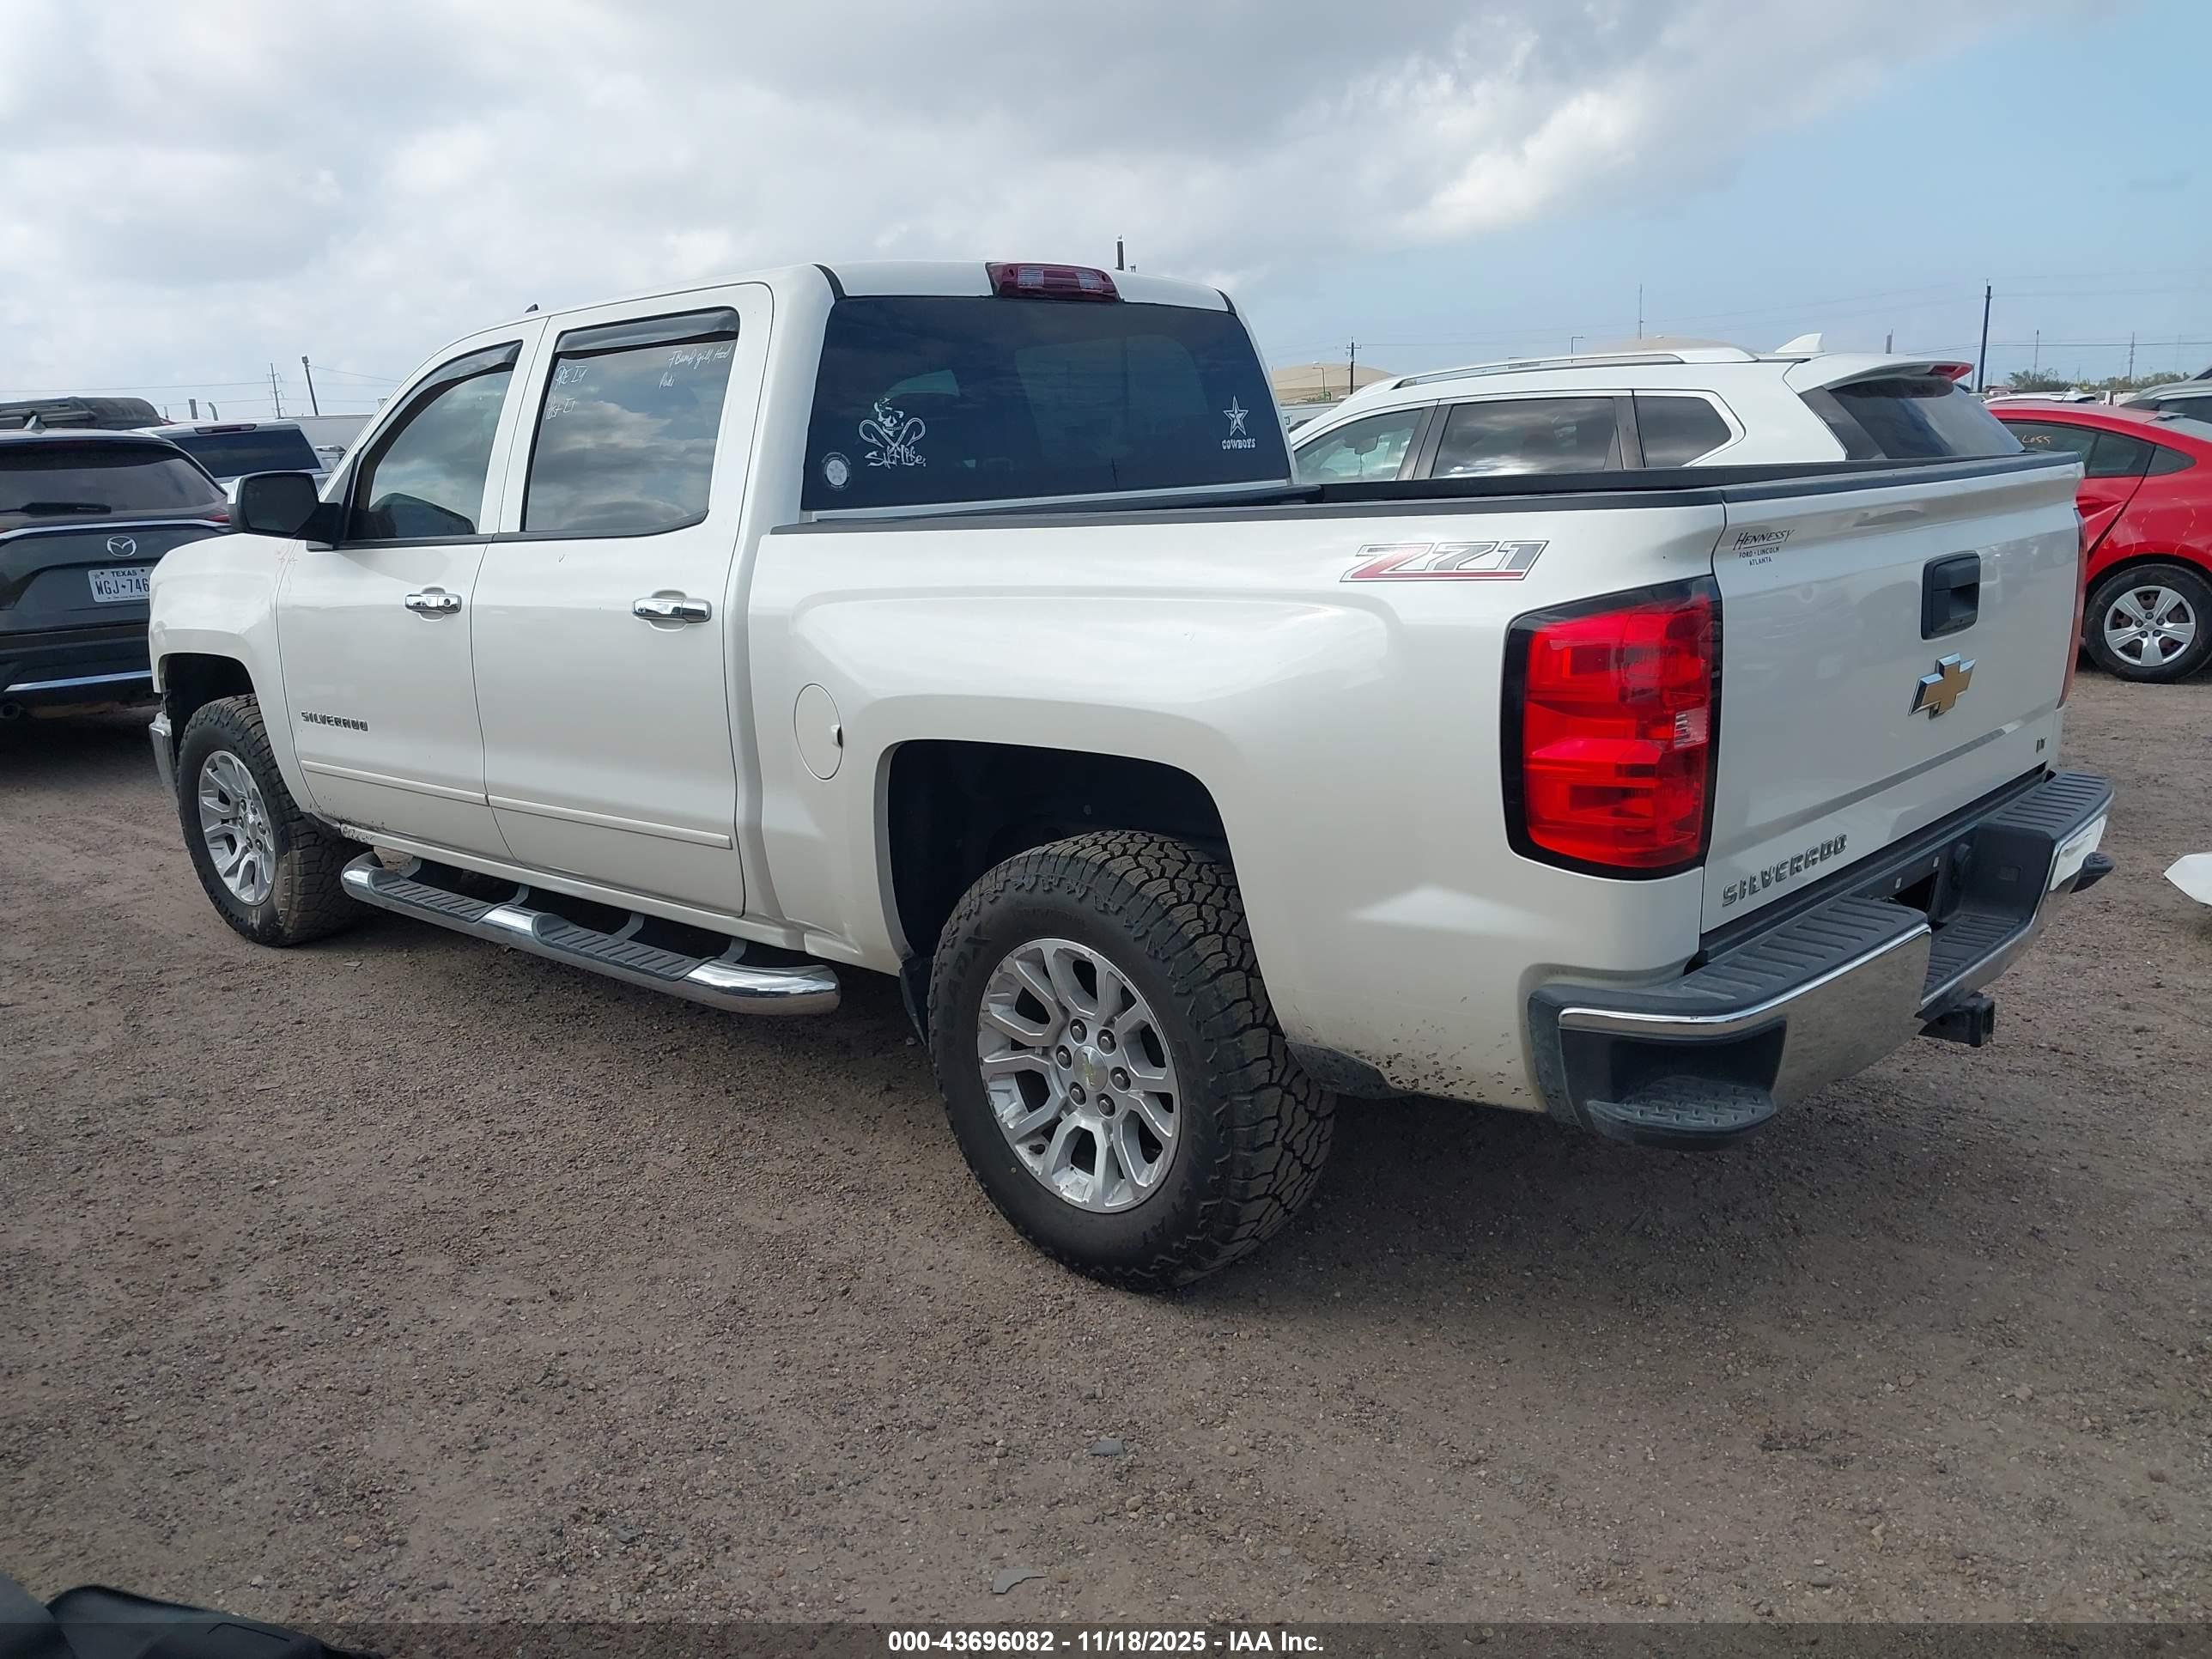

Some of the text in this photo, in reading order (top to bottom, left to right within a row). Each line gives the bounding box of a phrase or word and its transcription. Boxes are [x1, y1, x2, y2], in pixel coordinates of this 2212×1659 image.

[1221, 438, 1256, 450] COWBOYS
[1733, 529, 1796, 551] HENNESSY
[1757, 546, 1780, 556] LINCOLN
[1340, 540, 1550, 583] Z71
[1749, 556, 1772, 567] ATLANTA
[301, 710, 368, 732] SILVERADO
[1722, 833, 1848, 908] SILVERADO
